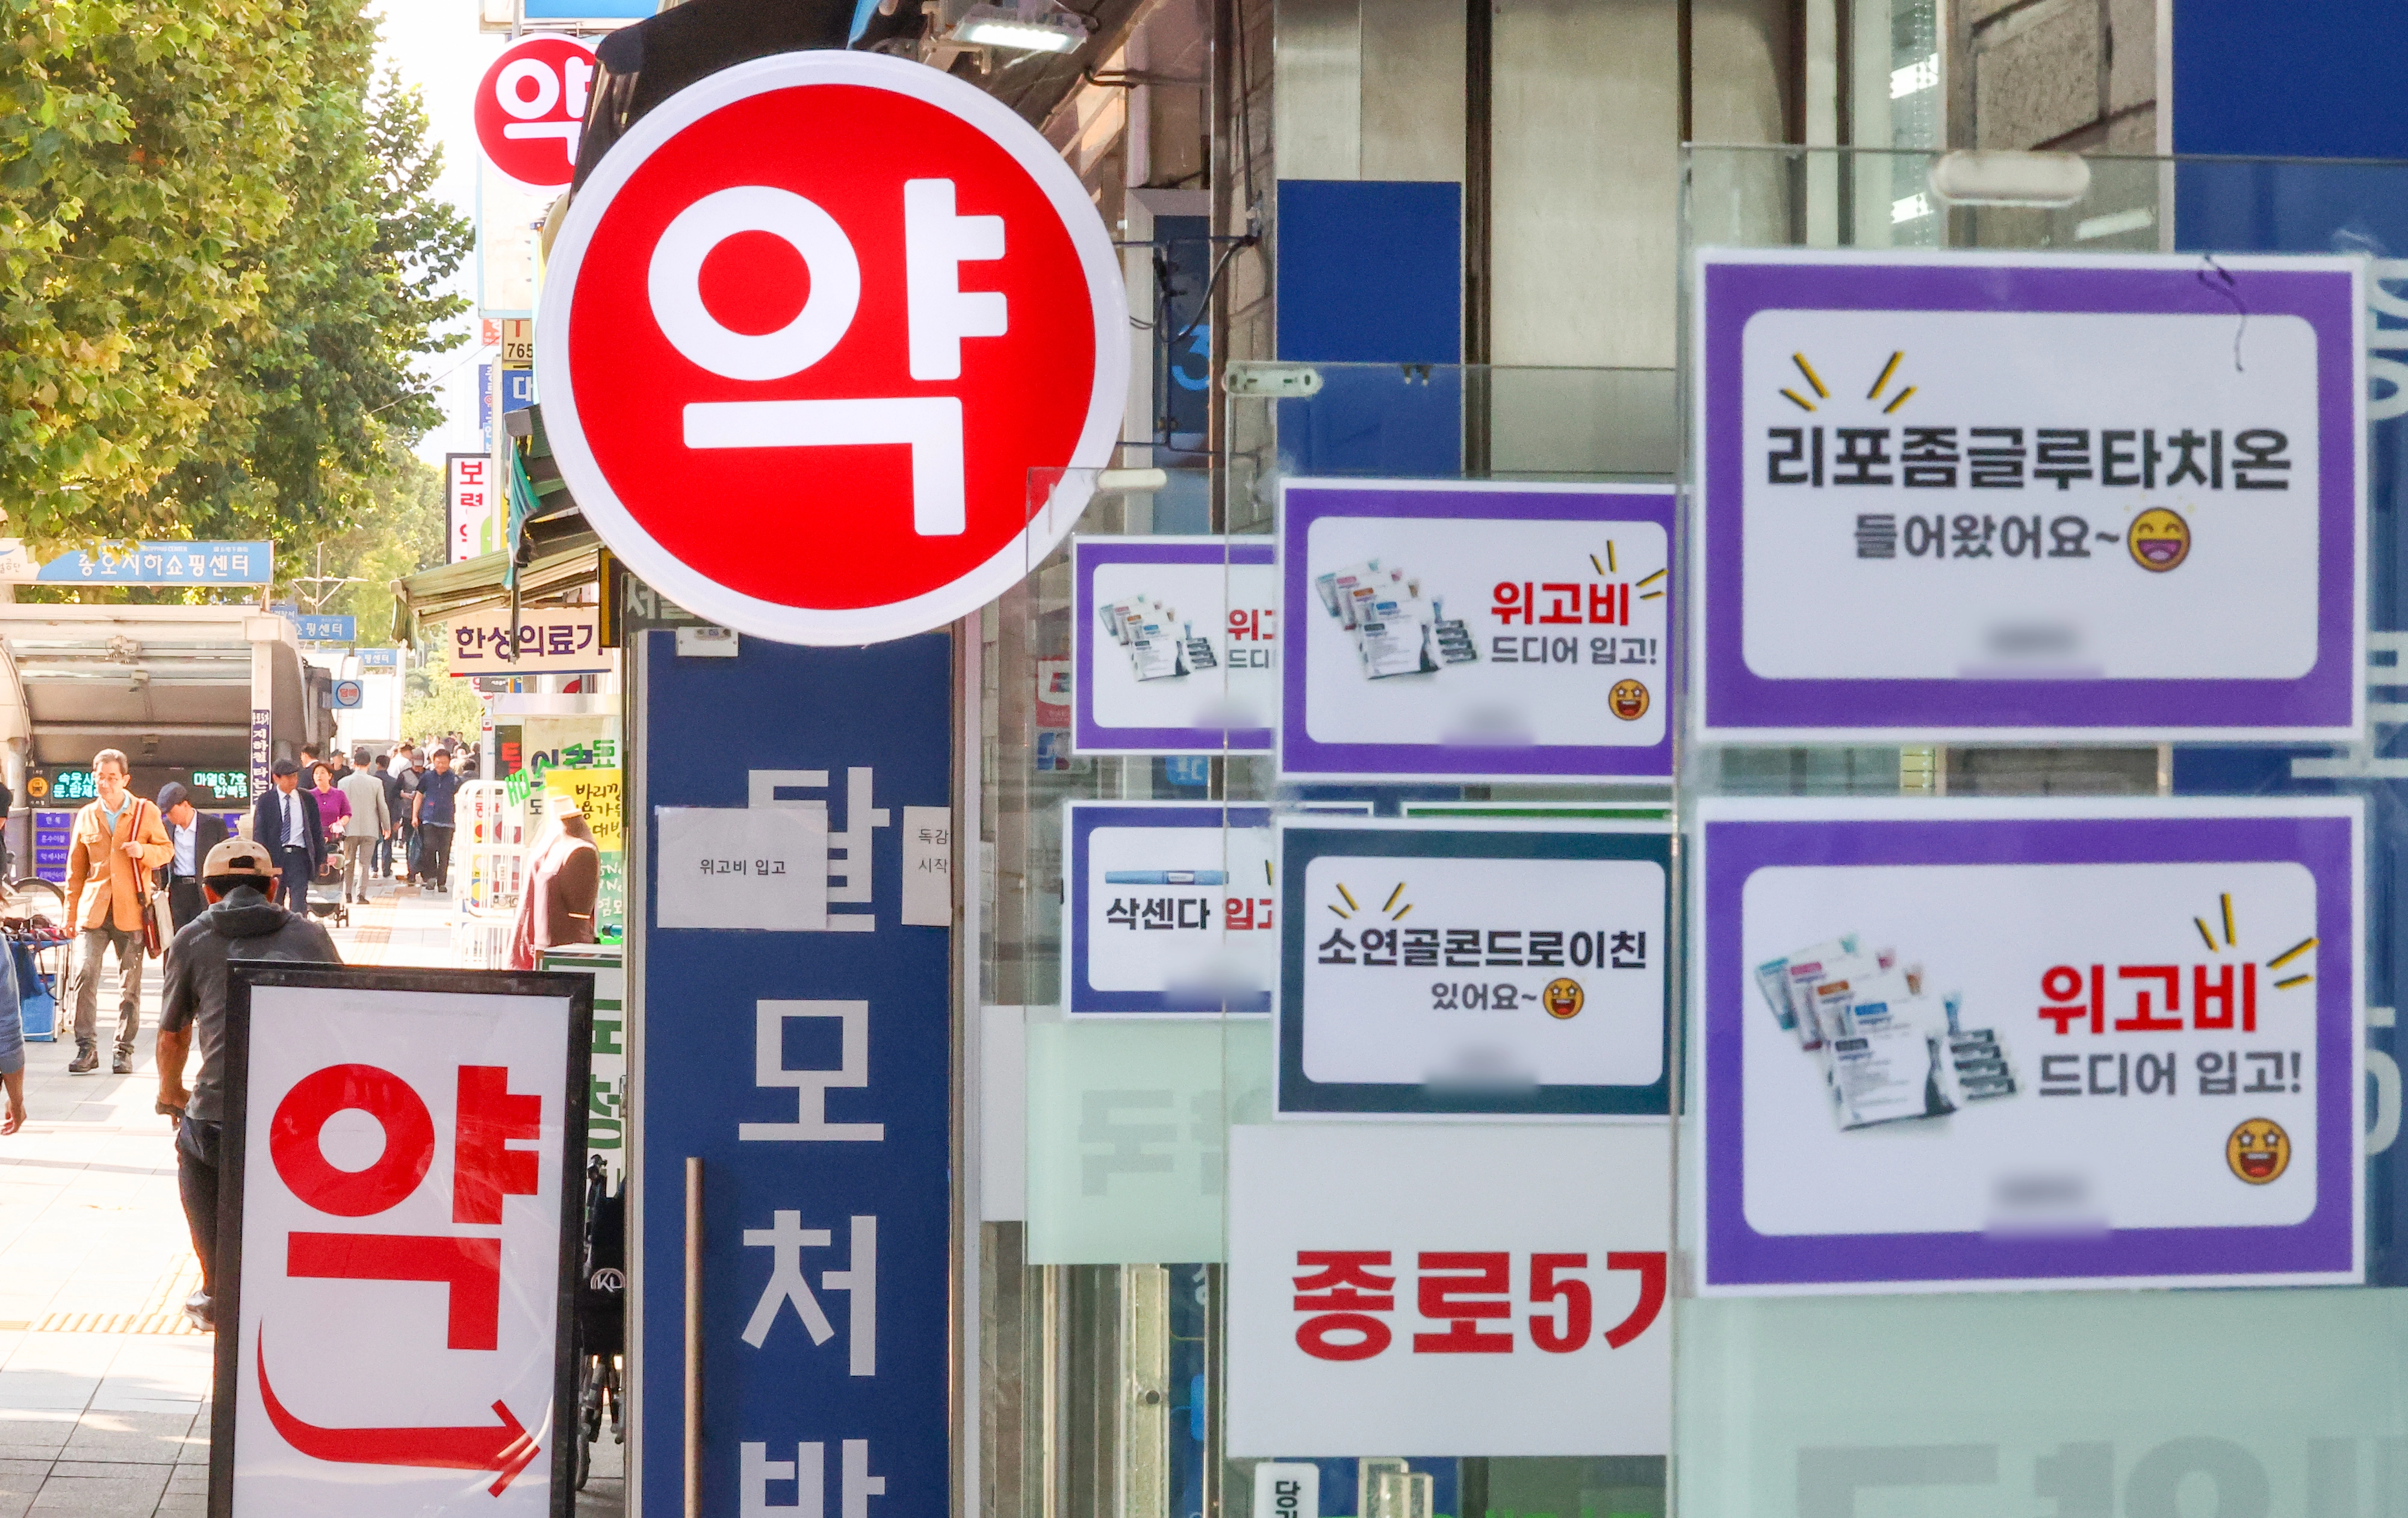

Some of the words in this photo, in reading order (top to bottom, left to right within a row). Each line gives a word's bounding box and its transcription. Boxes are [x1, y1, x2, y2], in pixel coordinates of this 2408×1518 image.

[495, 56, 594, 166] 약
[648, 178, 1008, 536] 약
[1767, 426, 2292, 491] 리포좀글루타치온
[1854, 513, 2121, 559] 들어왔어요~
[1491, 582, 1629, 626] 위고비
[1229, 649, 1275, 670] 드디
[1491, 636, 1578, 664] 드디어
[1590, 636, 1657, 665] 입고!
[919, 828, 949, 844] 독감
[700, 859, 746, 875] 위고비
[756, 859, 786, 876] 입고
[919, 858, 948, 873] 시작
[1106, 898, 1211, 930] 삭센다
[1318, 927, 1646, 969] 소연골콘드로이친
[1431, 982, 1538, 1010] 있어요~
[2038, 962, 2257, 1035] 위고비
[2038, 1052, 2177, 1097] 드디어
[2195, 1050, 2304, 1095] 입고!
[270, 1063, 542, 1351] 약
